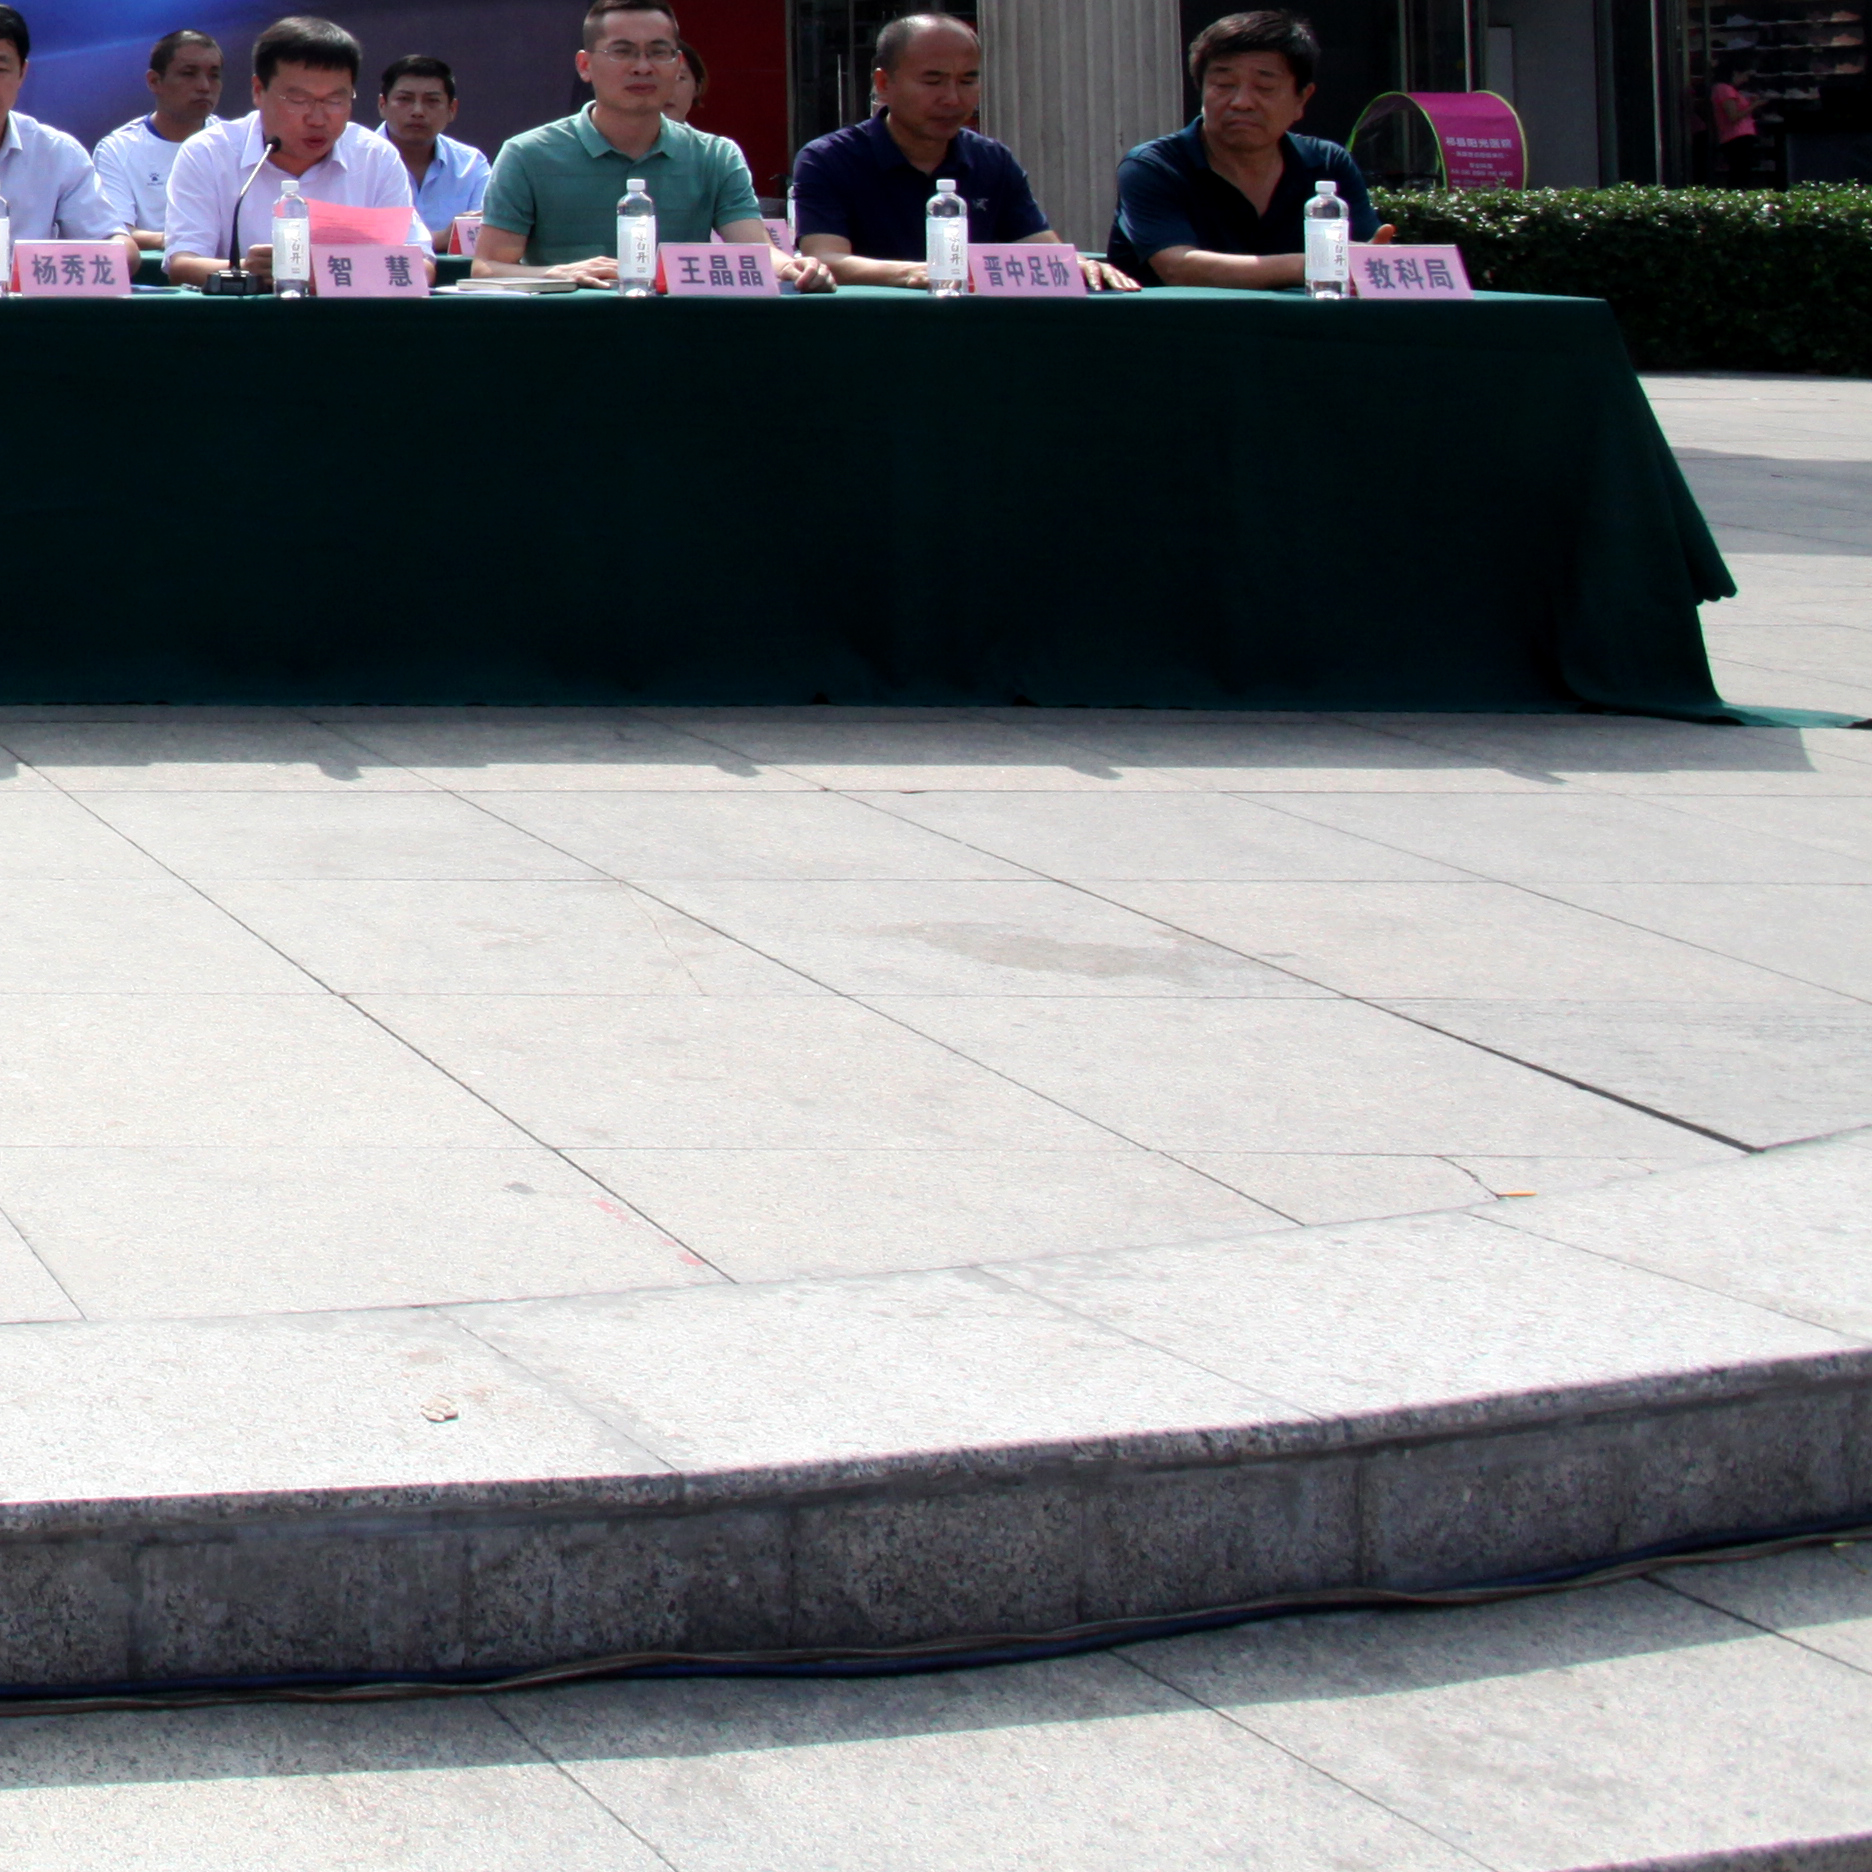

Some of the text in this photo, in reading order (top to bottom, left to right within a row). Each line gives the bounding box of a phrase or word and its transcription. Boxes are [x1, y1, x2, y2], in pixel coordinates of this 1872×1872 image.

[31, 254, 117, 287] 杨秀龙
[678, 254, 765, 288] 王晶晶
[982, 253, 1071, 288] 晋中足协
[1363, 257, 1456, 291] 教科局
